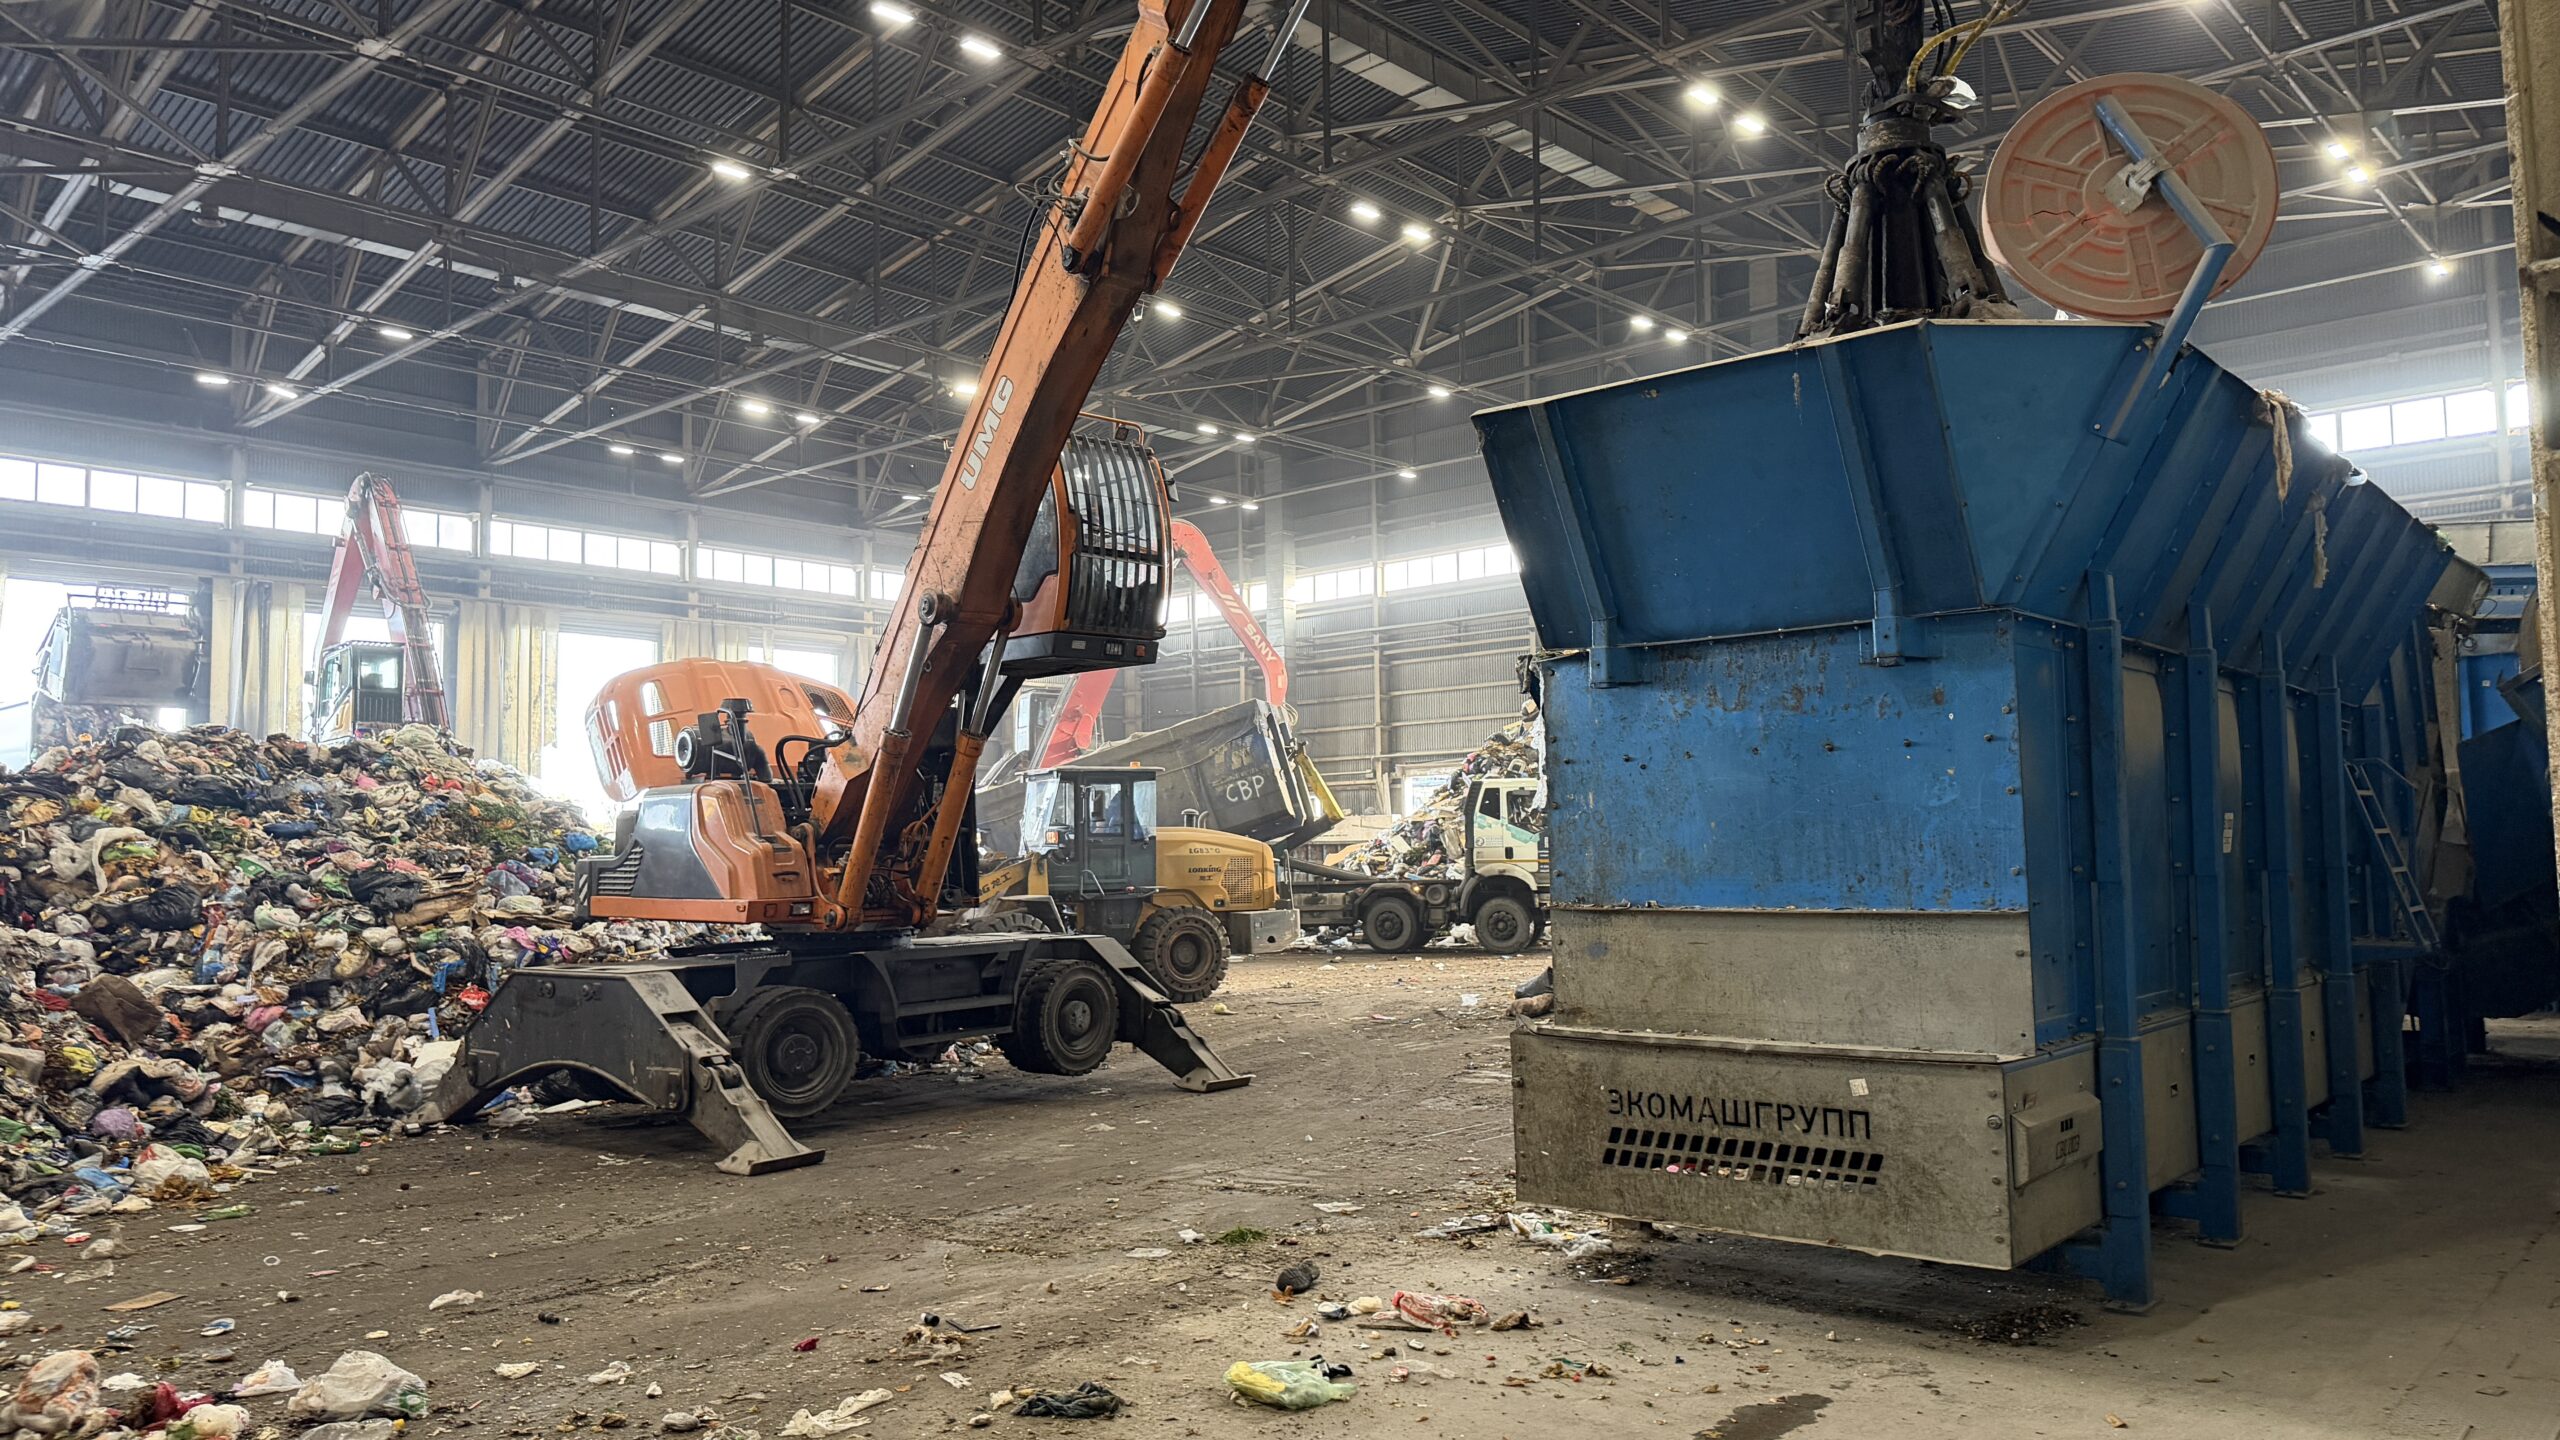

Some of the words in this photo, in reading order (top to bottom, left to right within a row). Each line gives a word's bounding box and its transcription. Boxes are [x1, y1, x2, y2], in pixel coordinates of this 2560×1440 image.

[960, 375, 1014, 491] UMG
[1244, 623, 1278, 662] SANY
[1608, 1089, 1871, 1140] ЭКОМАШГРУПП
